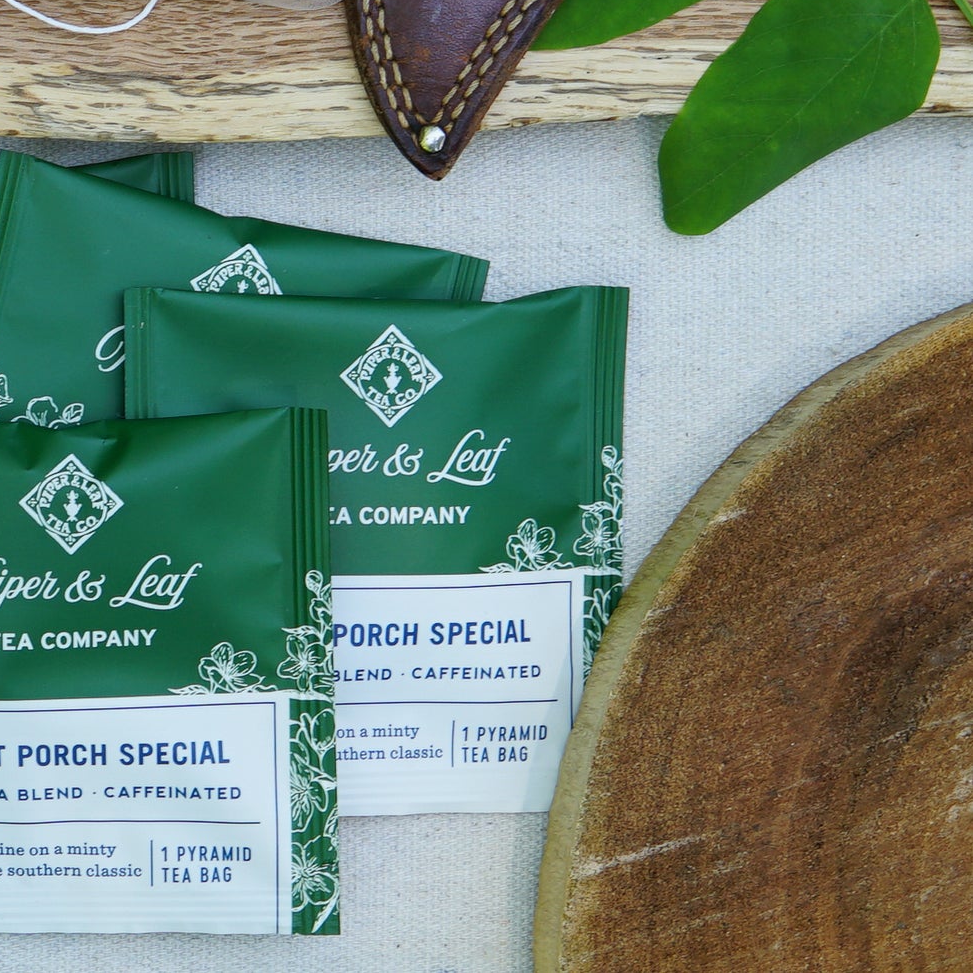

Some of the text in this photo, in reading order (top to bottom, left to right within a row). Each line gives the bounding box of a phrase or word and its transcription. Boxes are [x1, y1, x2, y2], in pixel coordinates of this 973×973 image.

[208, 263, 244, 293] PIPER
[359, 347, 392, 381] PIPER
[366, 386, 390, 406] TEA
[382, 443, 424, 477] &
[426, 429, 512, 486] Leaf
[39, 474, 70, 508] PIPER
[46, 513, 71, 533] TEA
[359, 506, 471, 525] COMPANY
[64, 570, 106, 603] &
[109, 554, 203, 611] Leaf
[41, 628, 158, 649] COMPANY
[332, 619, 531, 647] PORCH SPECIAL
[411, 664, 542, 680] CAFFEINATED
[336, 724, 419, 743] on a minty
[461, 725, 548, 743] 1 PYRAMID
[18, 743, 108, 767] PORCH
[119, 740, 231, 765] SPECIAL
[390, 745, 443, 760] classic
[462, 745, 529, 763] TEA BAG
[18, 786, 84, 802] BLEND
[104, 785, 243, 801] CAFFEINATED
[29, 845, 50, 857] on
[54, 846, 63, 856] a
[67, 842, 117, 859] minty
[161, 846, 252, 862] 1 PYRAMID
[7, 863, 82, 877] southern
[85, 864, 143, 877] classic
[161, 867, 232, 883] TEA BAG
